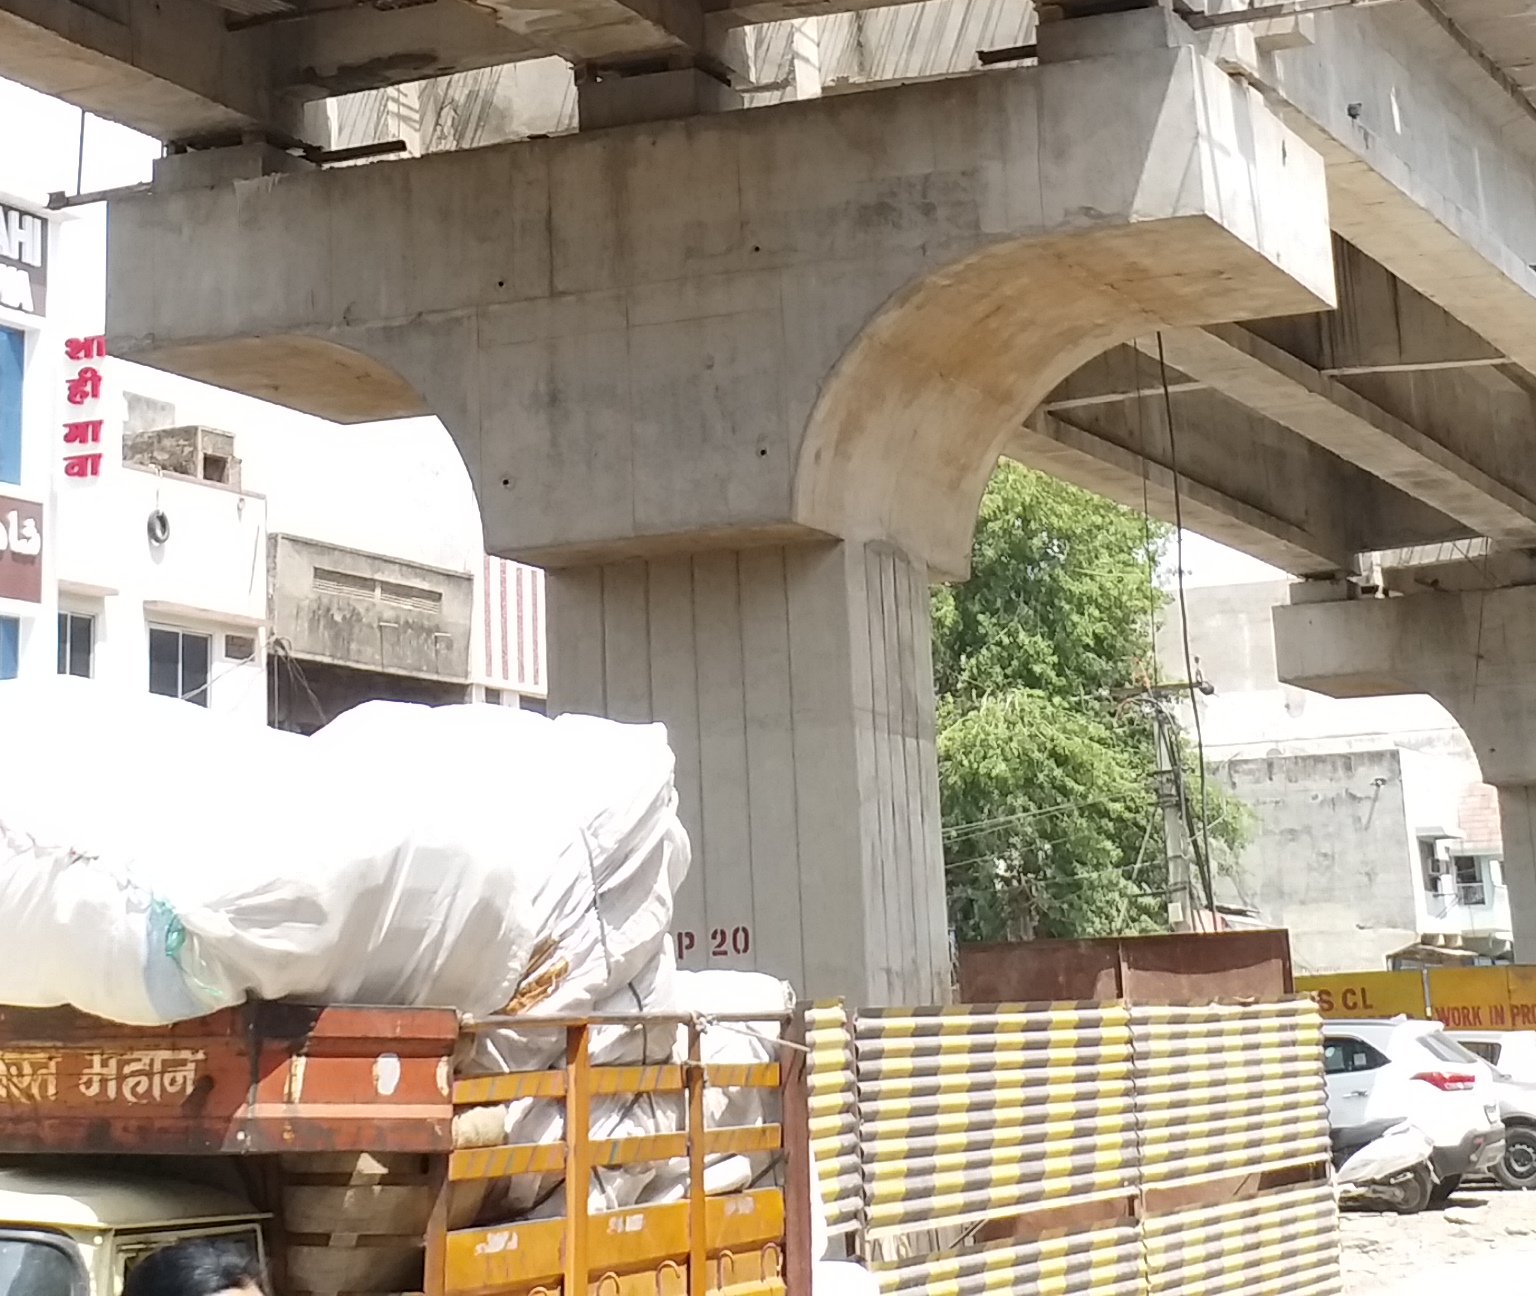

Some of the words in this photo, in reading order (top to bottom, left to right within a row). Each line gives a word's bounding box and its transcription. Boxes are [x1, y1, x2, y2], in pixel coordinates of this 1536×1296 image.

[677, 931, 695, 960] P
[711, 926, 750, 956] 20
[1436, 1006, 1482, 1027] WORK
[1489, 1005, 1505, 1025] IN
[78, 1049, 206, 1103] महान
